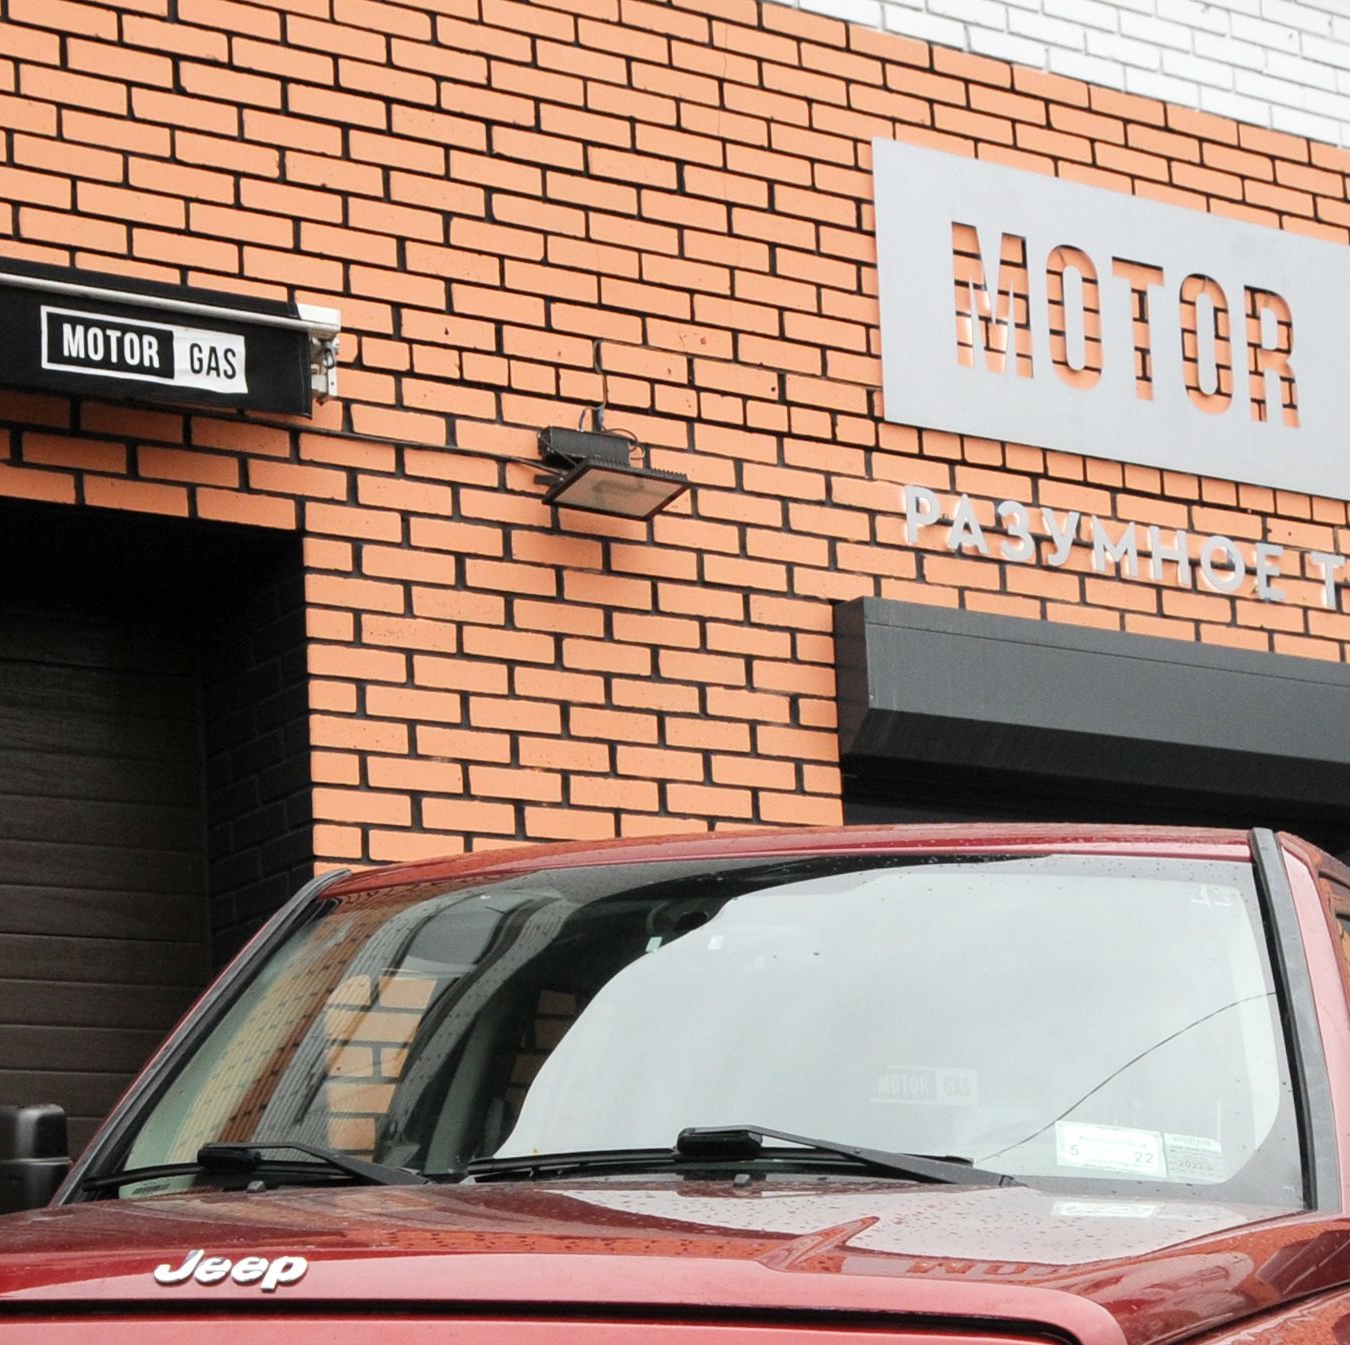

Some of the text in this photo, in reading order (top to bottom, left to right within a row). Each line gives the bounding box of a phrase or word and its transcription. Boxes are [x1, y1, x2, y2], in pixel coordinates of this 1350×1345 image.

[62, 322, 237, 380] MOTOR GAS
[951, 221, 1301, 429] MOTOR
[902, 485, 1287, 602] РАЗУМНОЕ
[153, 1249, 309, 1293] Jeep
